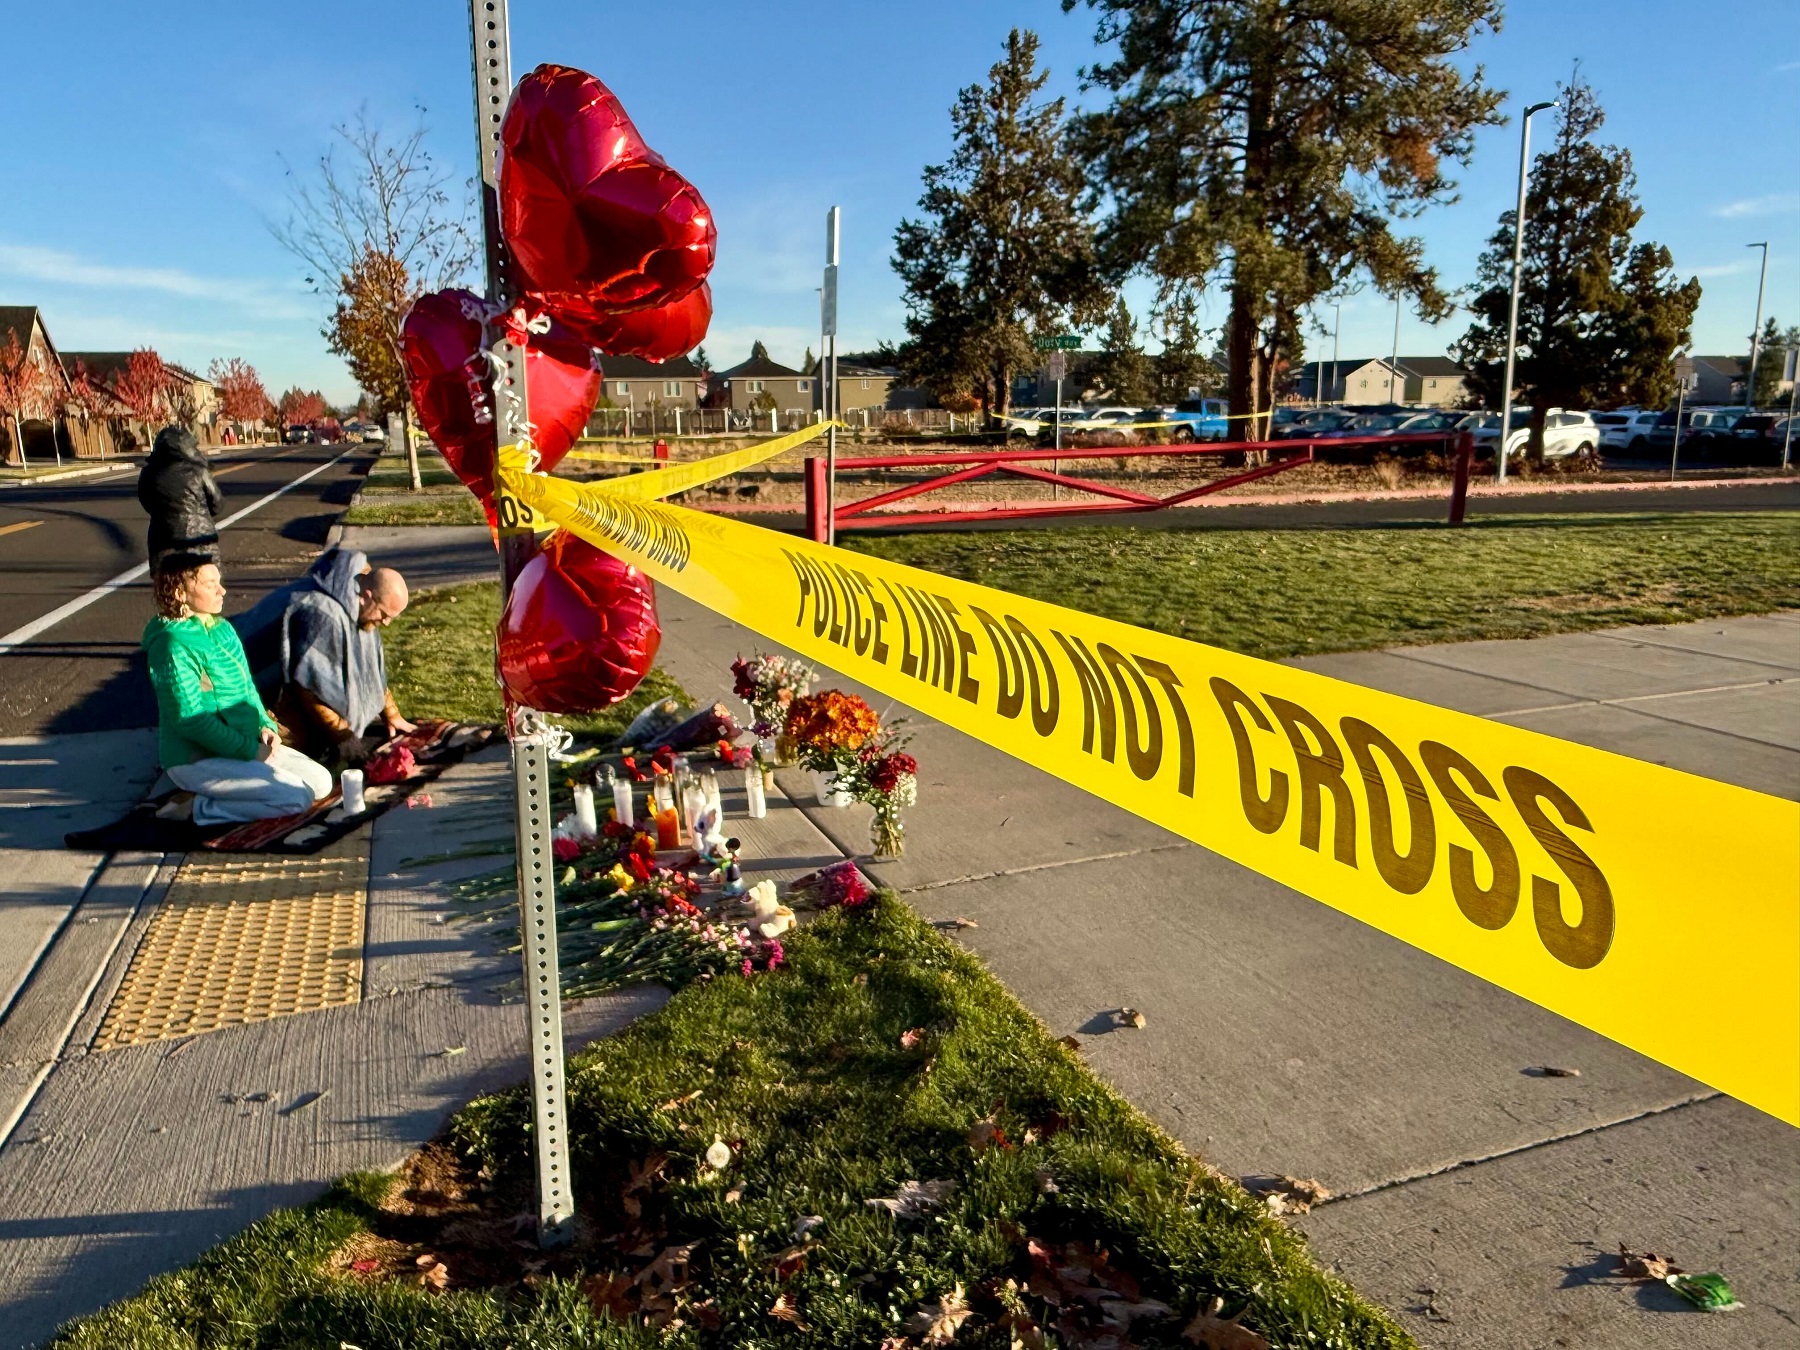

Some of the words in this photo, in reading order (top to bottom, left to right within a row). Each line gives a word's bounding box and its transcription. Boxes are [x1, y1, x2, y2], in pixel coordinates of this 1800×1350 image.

[779, 547, 890, 666] POLICE
[876, 577, 980, 705] LINE
[968, 604, 1061, 738] DO
[1049, 629, 1196, 799] NOT
[1208, 676, 1616, 970] CROSS
